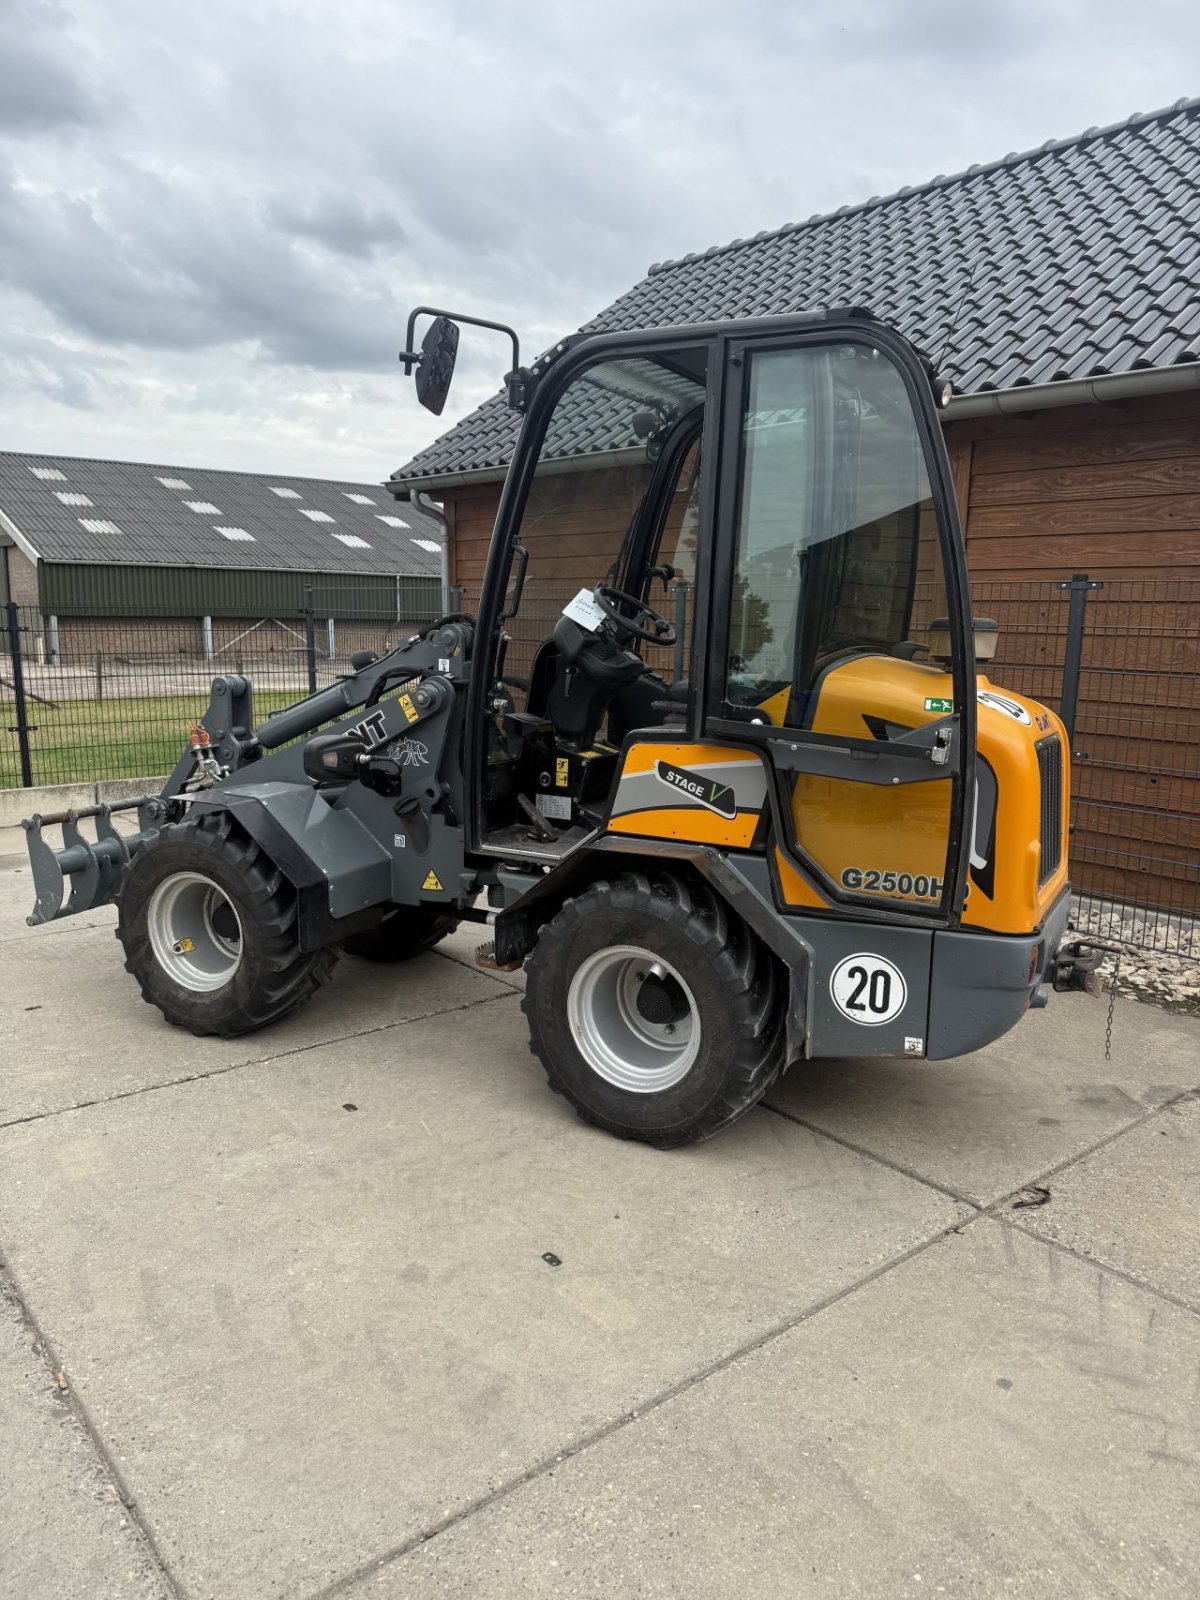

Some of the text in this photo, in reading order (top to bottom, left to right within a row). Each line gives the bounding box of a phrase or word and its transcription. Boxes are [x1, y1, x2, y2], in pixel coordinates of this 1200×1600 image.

[342, 709, 387, 750] NT
[666, 771, 732, 802] STAGE V
[841, 867, 970, 901] G2500H
[846, 966, 891, 1014] 20
